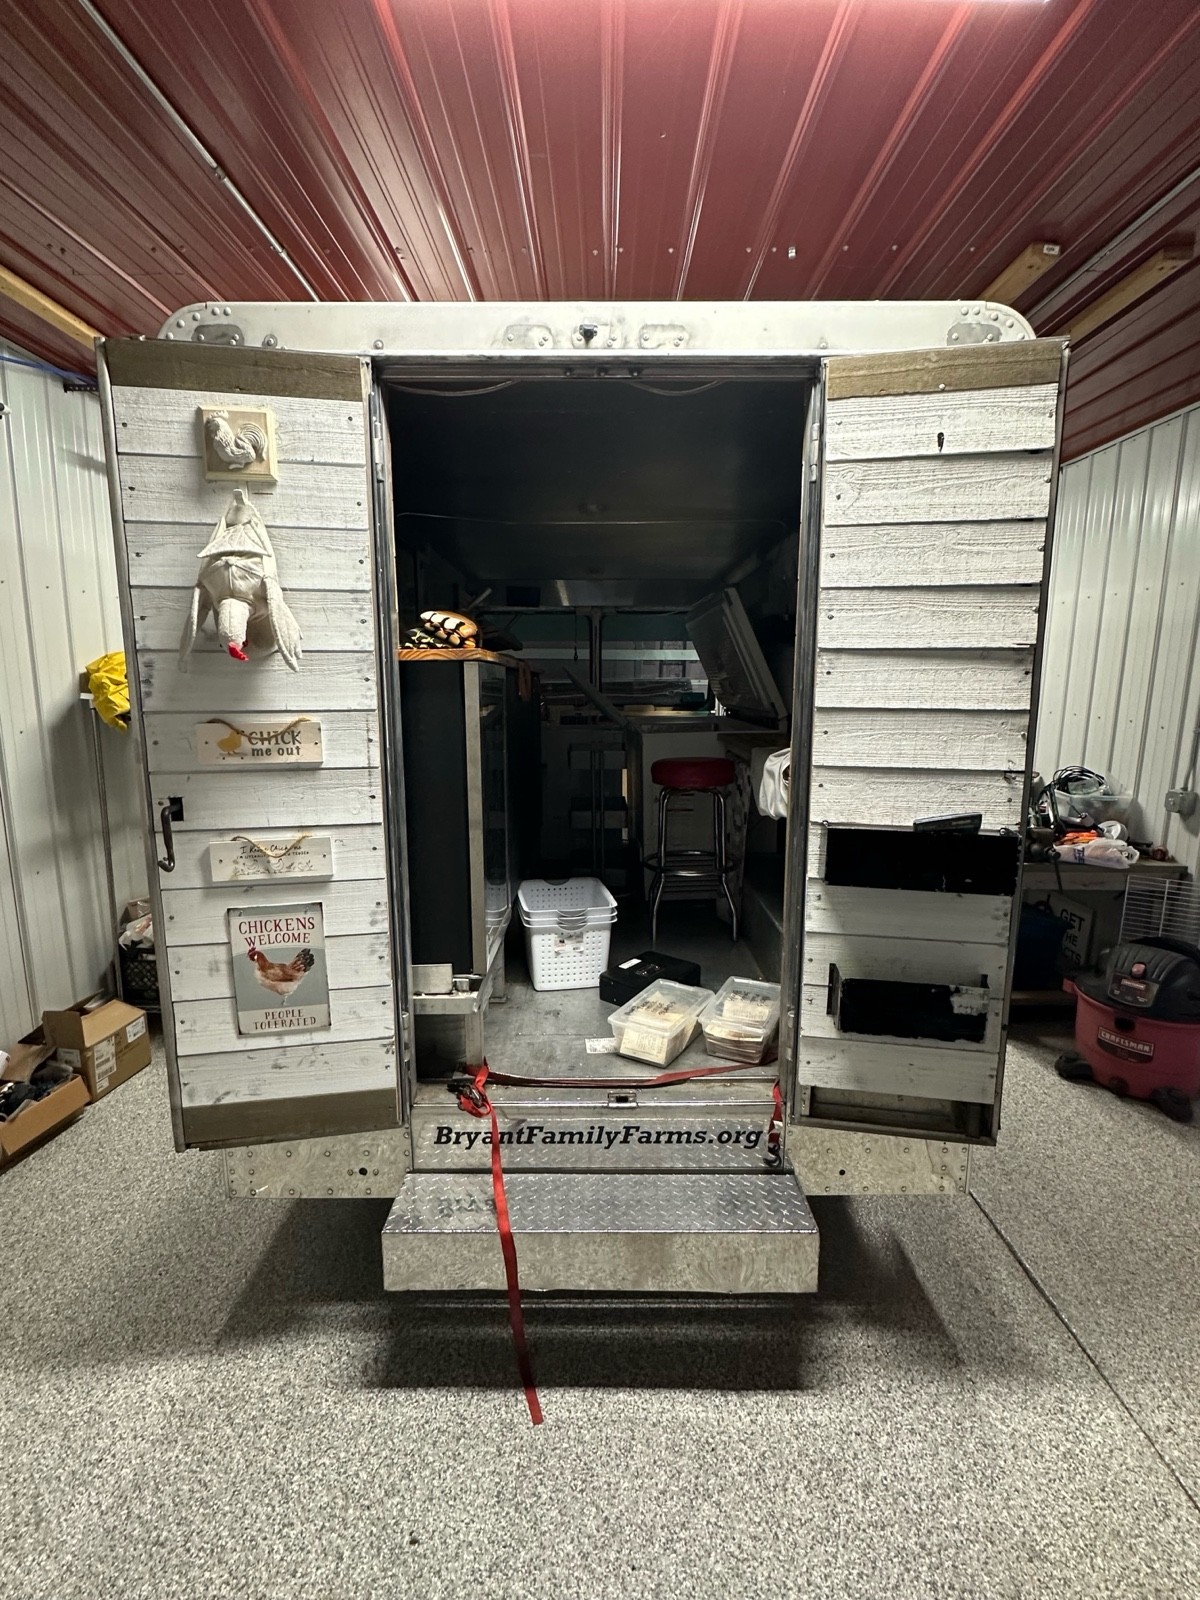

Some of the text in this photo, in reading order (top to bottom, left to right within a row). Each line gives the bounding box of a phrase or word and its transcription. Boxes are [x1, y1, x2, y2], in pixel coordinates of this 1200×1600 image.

[248, 730, 302, 746] CHICK
[251, 745, 302, 757] me out
[238, 916, 315, 936] CHICKENS
[1060, 908, 1085, 931] GET
[245, 932, 311, 947] WELCOME
[1065, 933, 1078, 947] HE
[264, 1008, 304, 1020] PEOPLE
[254, 1016, 316, 1030] TOLERATED
[1100, 1031, 1150, 1053] CRAFTSMAN
[433, 1125, 763, 1150] BryantFamilyFarms.org
